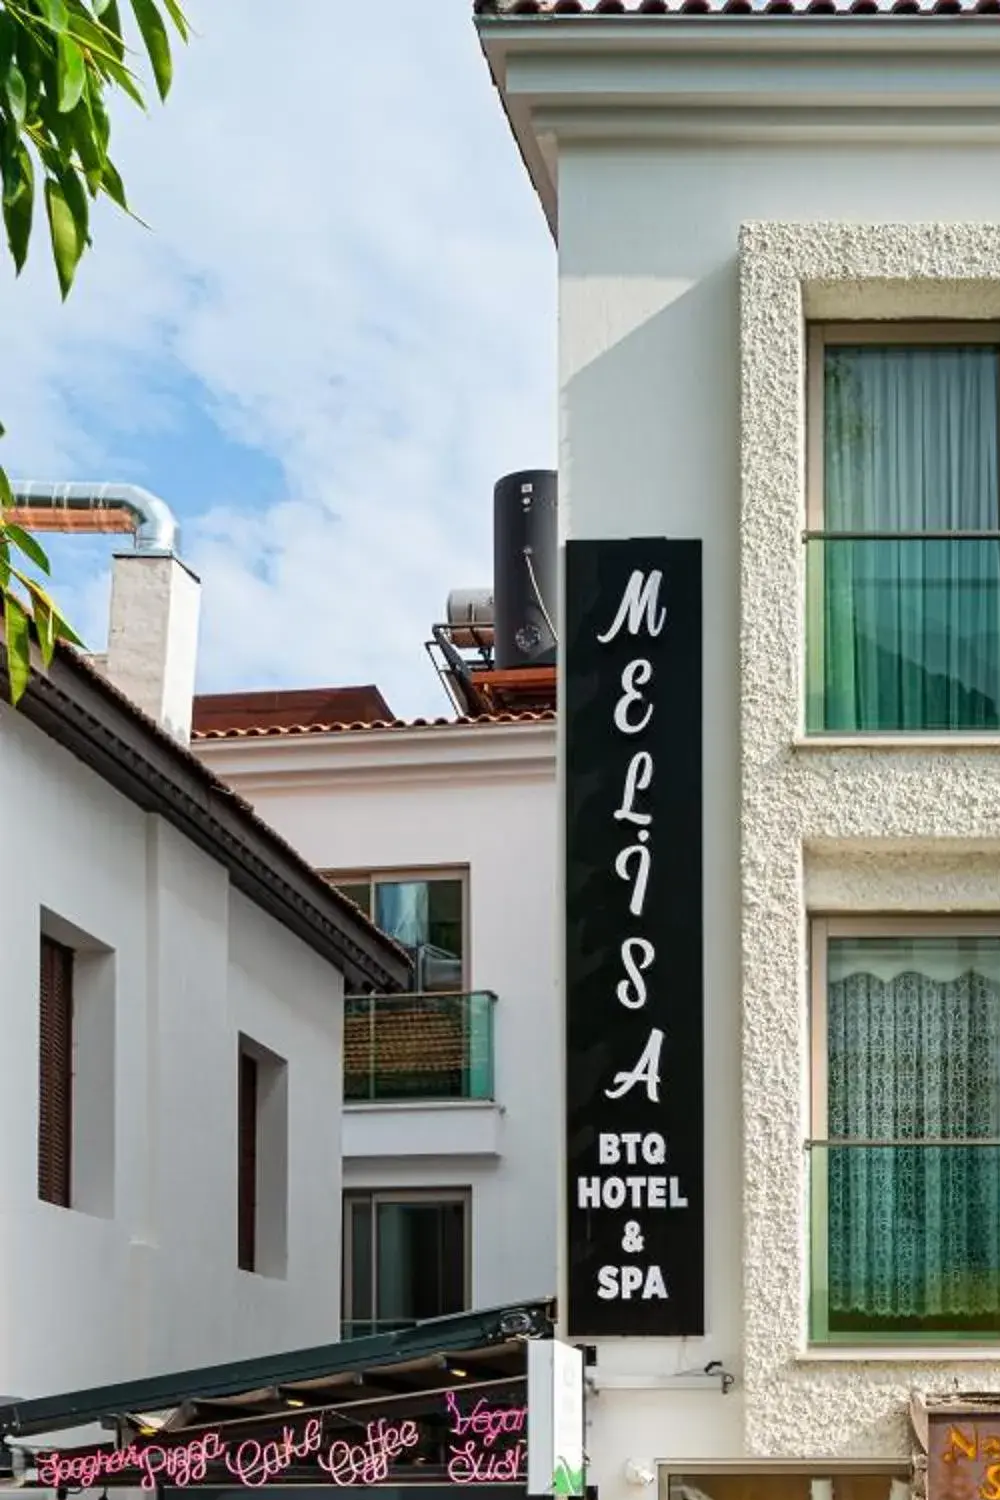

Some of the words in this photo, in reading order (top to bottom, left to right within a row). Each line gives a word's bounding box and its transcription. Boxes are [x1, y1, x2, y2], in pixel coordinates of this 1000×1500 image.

[599, 1132, 667, 1165] BTQ
[577, 1176, 689, 1209] HOTEL
[621, 1220, 645, 1253] &
[597, 1265, 669, 1300] SPA
[138, 1432, 225, 1490] Pizza
[226, 1418, 321, 1487] Cake
[317, 1418, 419, 1486] Coffee
